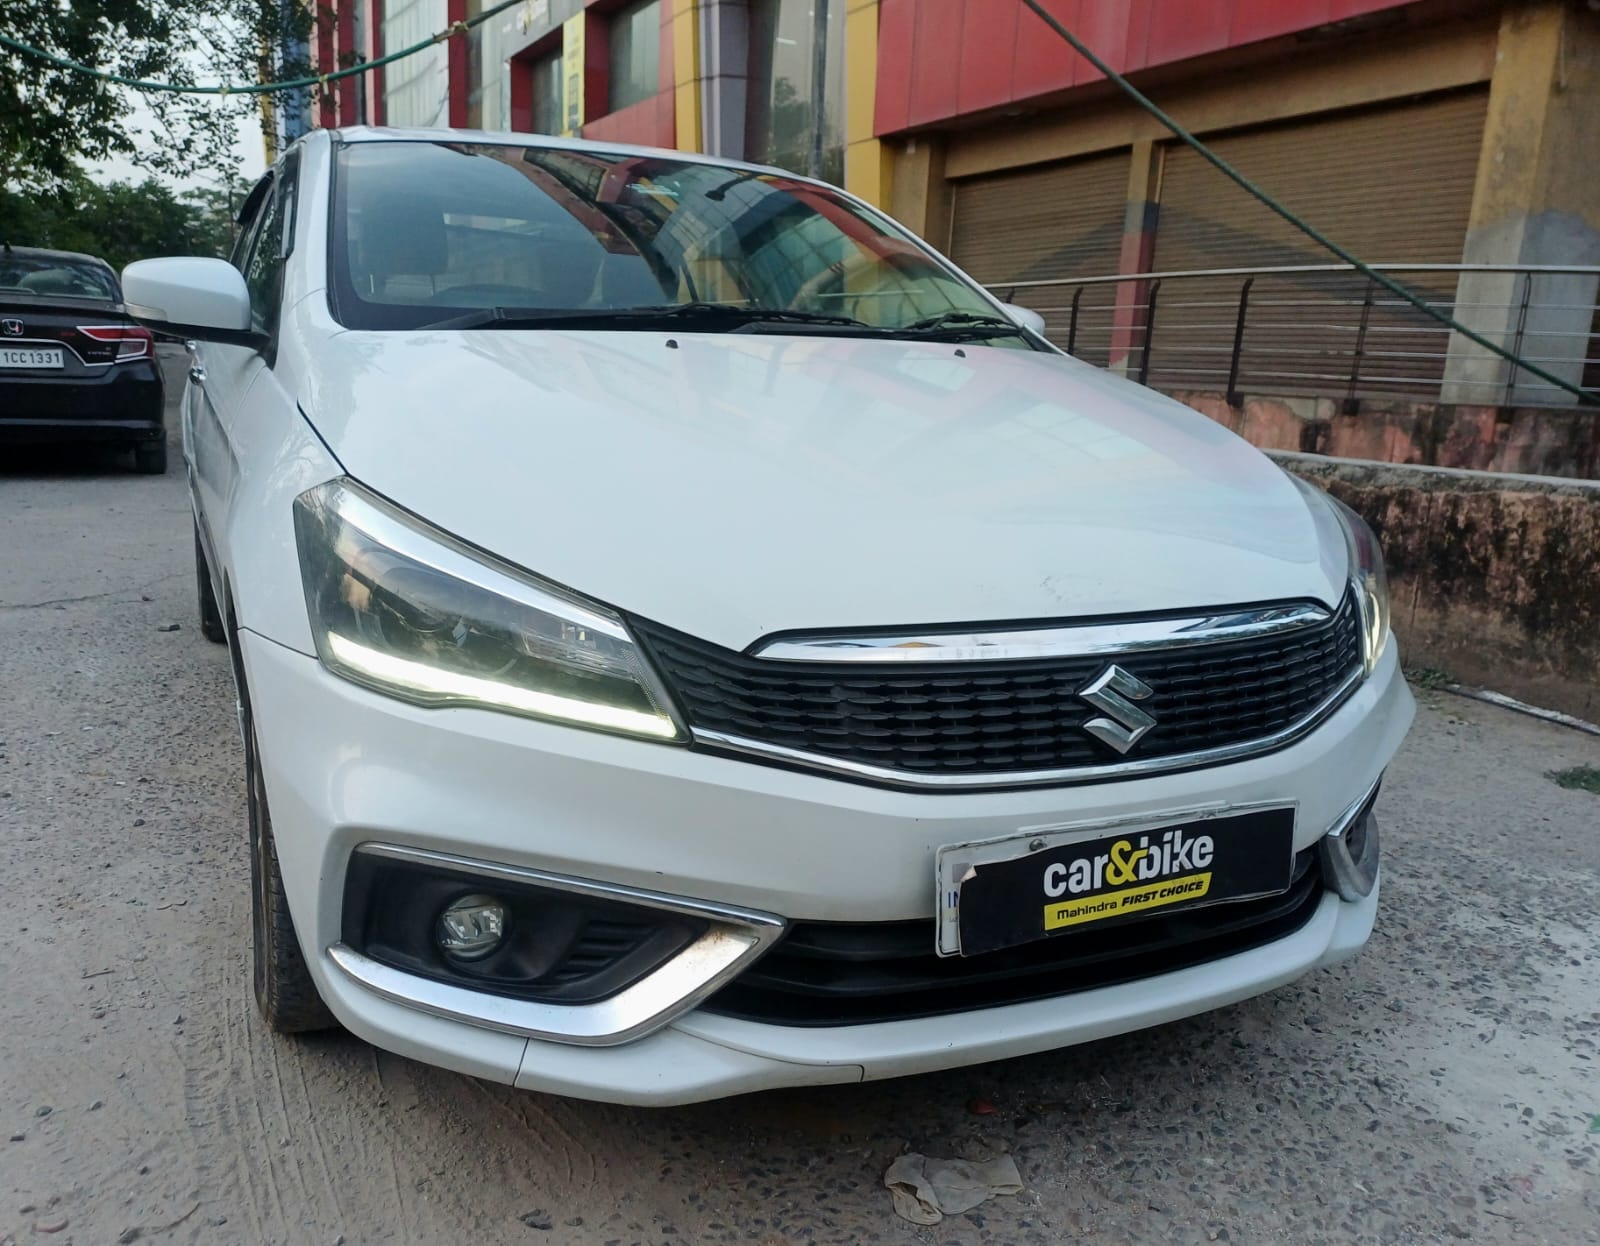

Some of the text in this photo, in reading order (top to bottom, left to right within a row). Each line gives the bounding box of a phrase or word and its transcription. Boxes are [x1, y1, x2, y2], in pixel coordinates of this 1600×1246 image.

[3, 351, 60, 364] 1CC1331
[1056, 880, 1204, 920] Mahindra FIRST CHOICE
